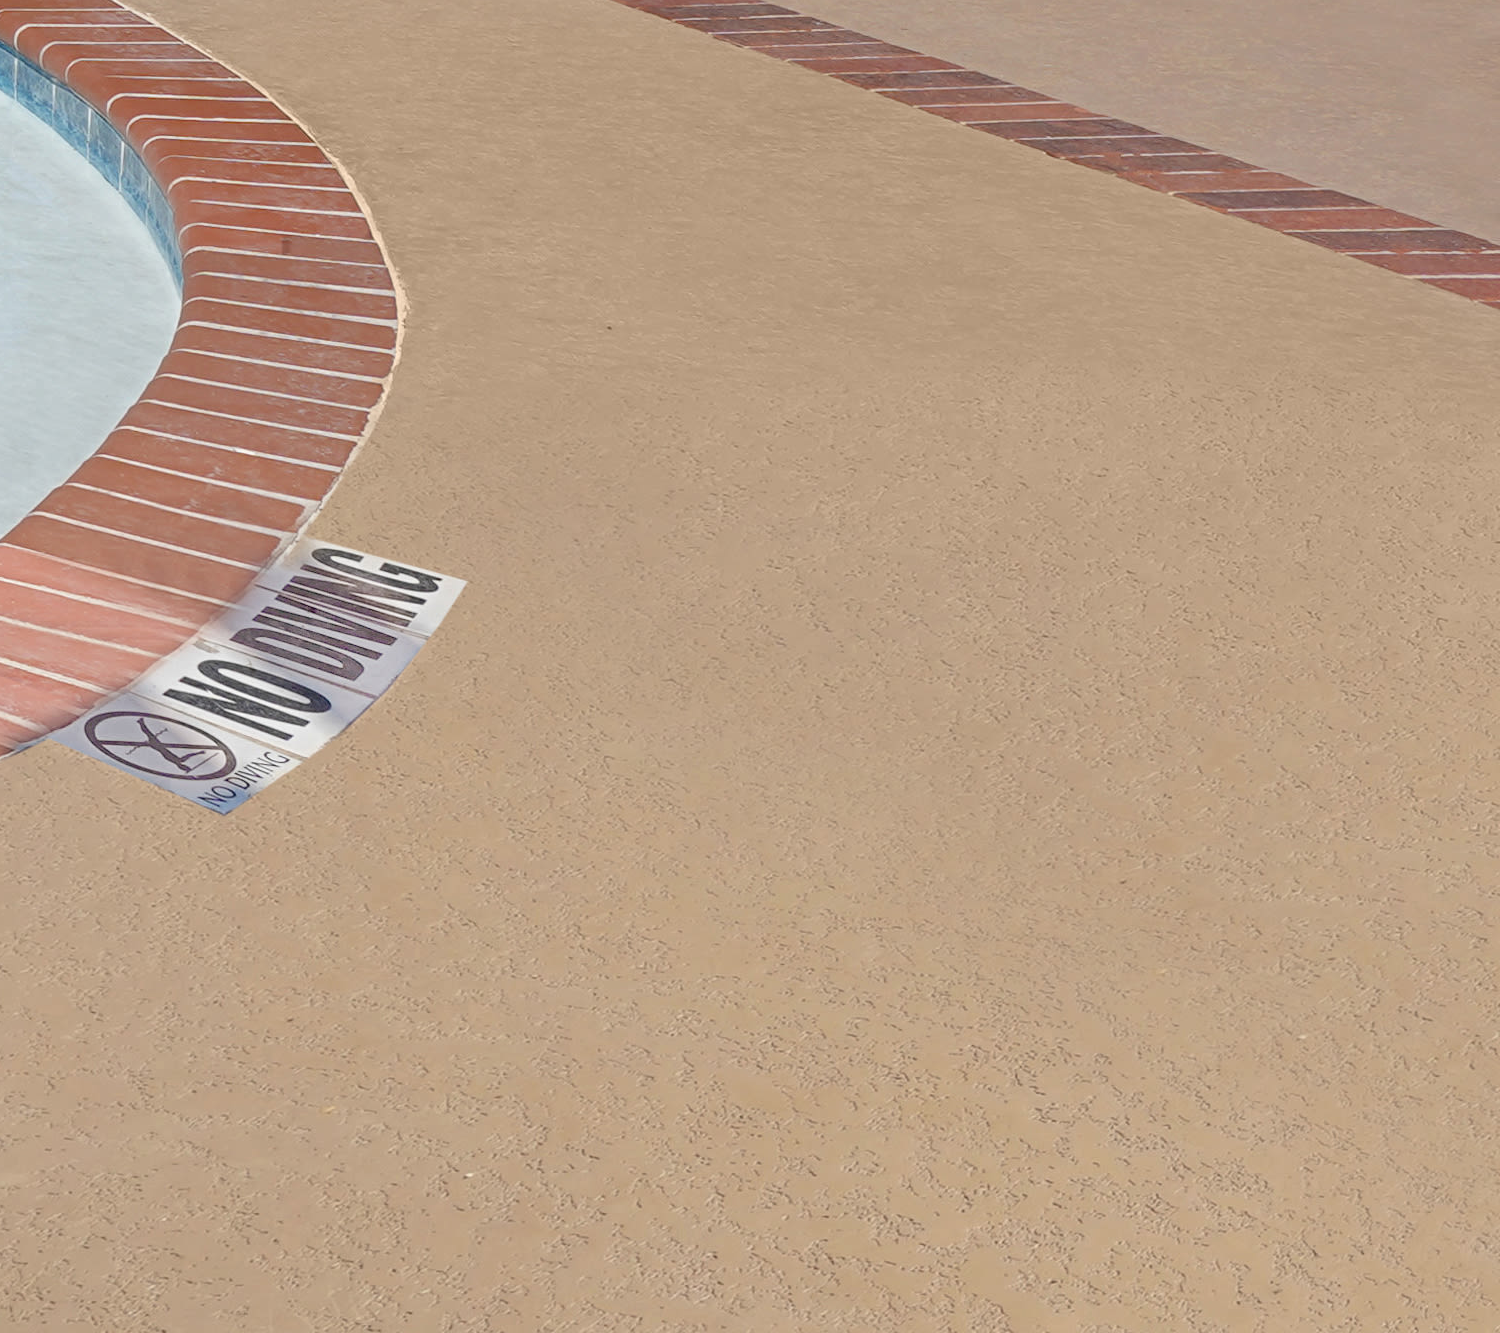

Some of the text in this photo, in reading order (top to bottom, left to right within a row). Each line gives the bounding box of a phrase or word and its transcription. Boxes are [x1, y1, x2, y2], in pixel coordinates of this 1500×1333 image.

[163, 546, 443, 741] NO DIVING
[197, 751, 290, 807] NO DIVING
